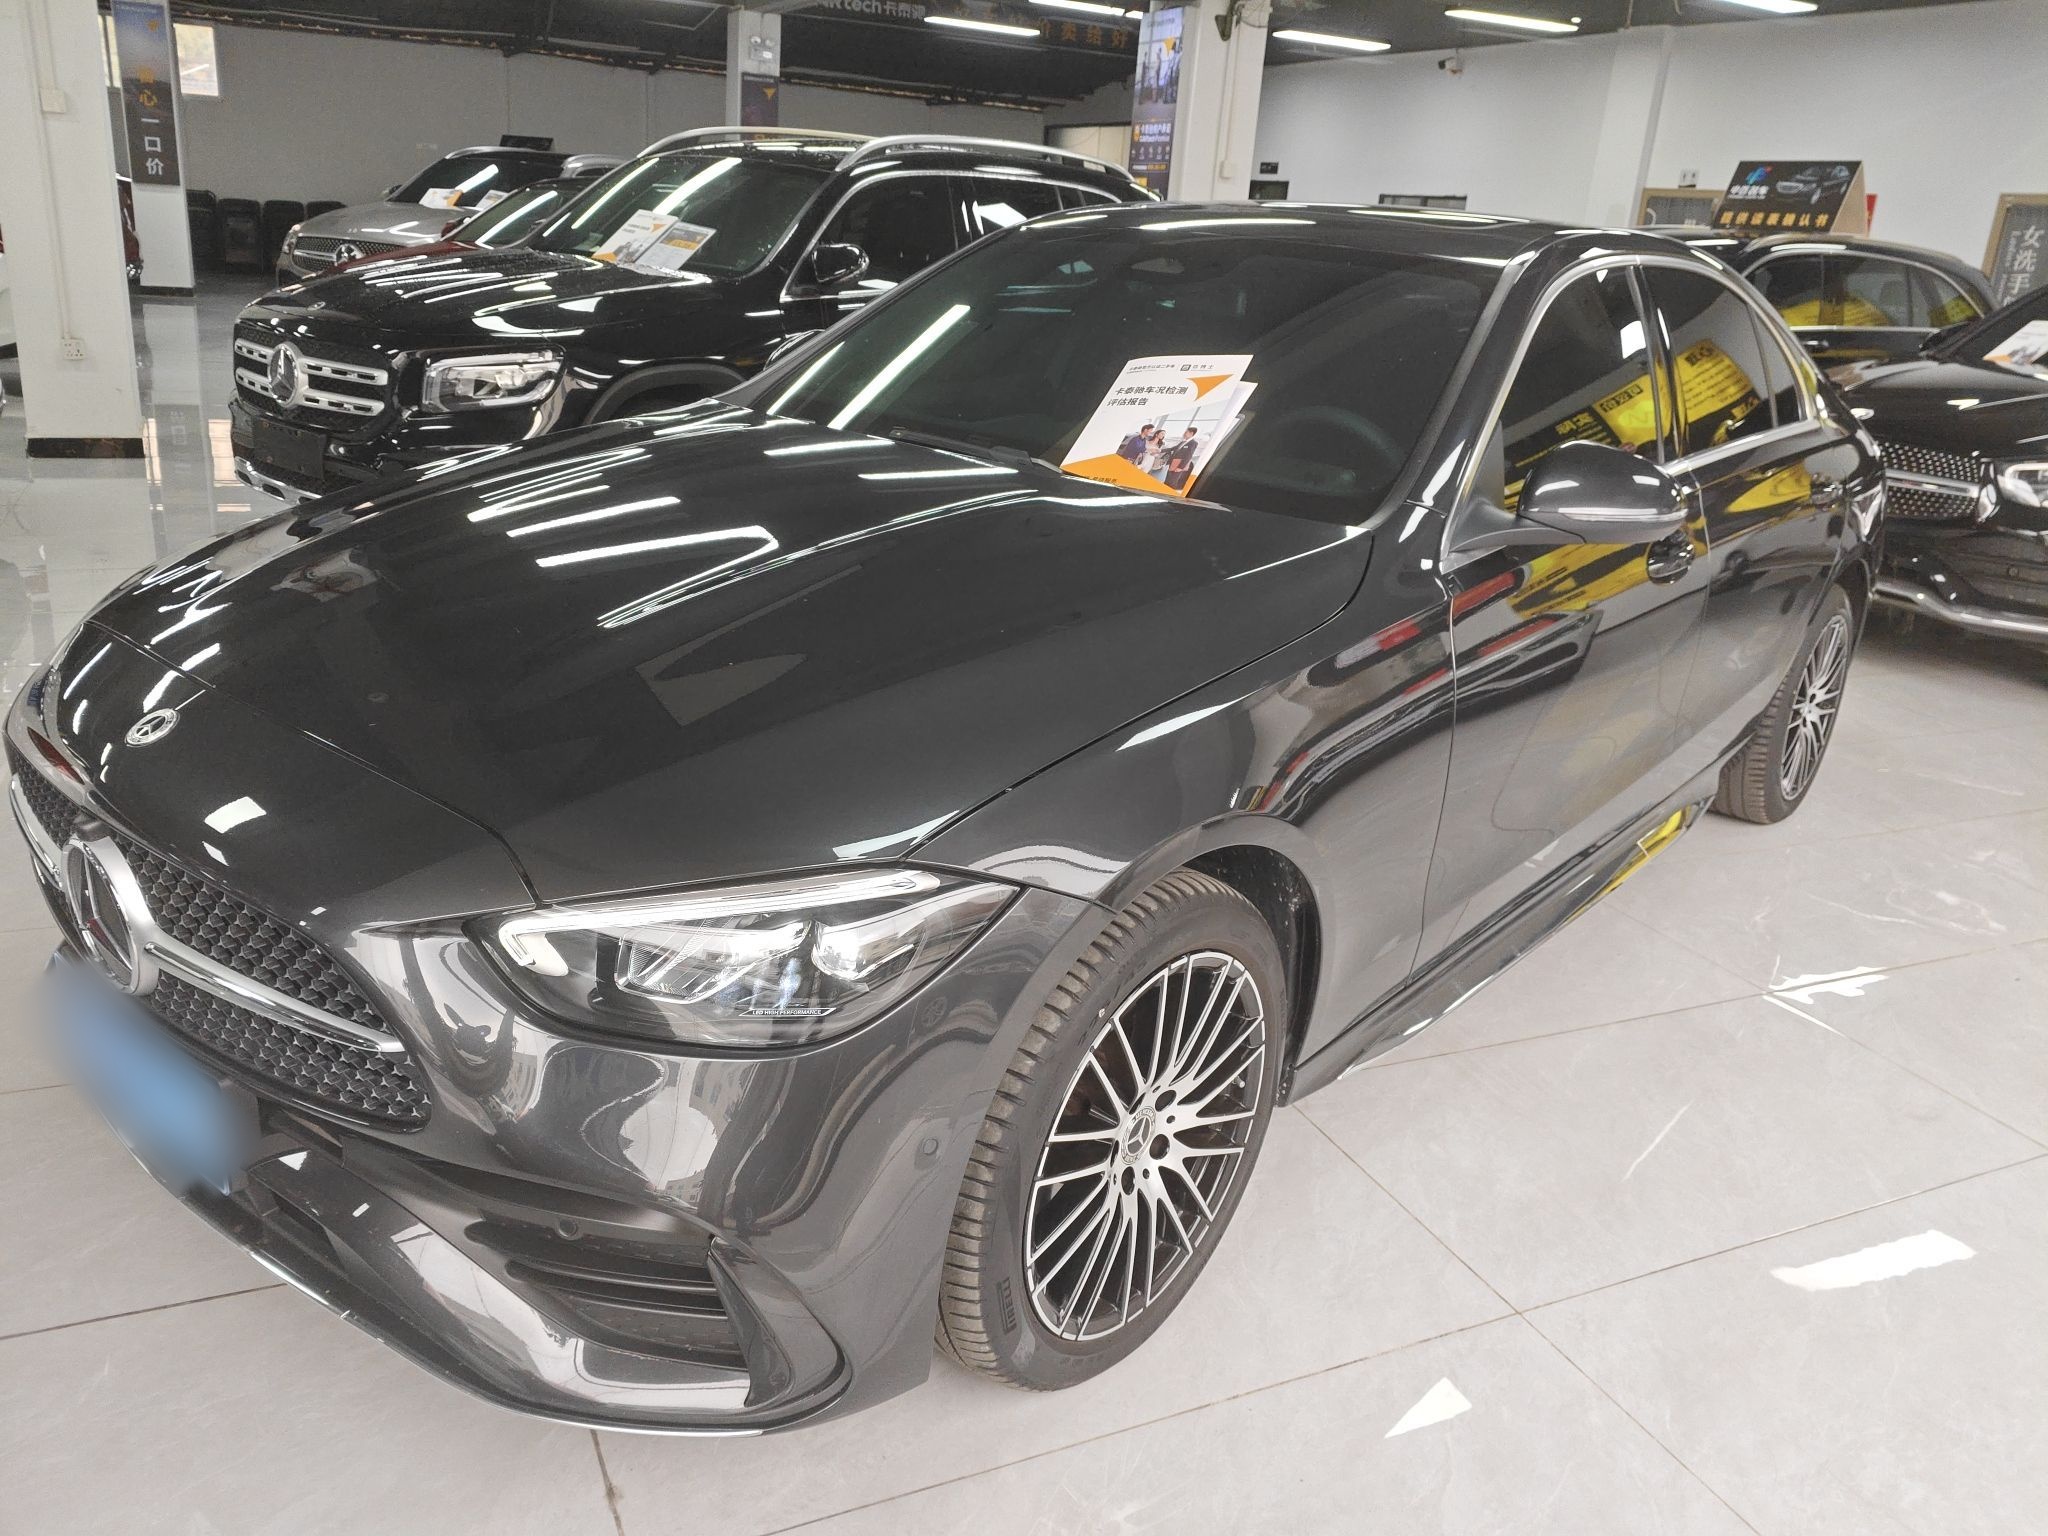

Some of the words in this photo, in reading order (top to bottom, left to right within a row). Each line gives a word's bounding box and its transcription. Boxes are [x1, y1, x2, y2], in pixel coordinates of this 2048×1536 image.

[1114, 385, 1189, 396] 卡泰驰车况检测
[1106, 397, 1149, 407] 评估报告
